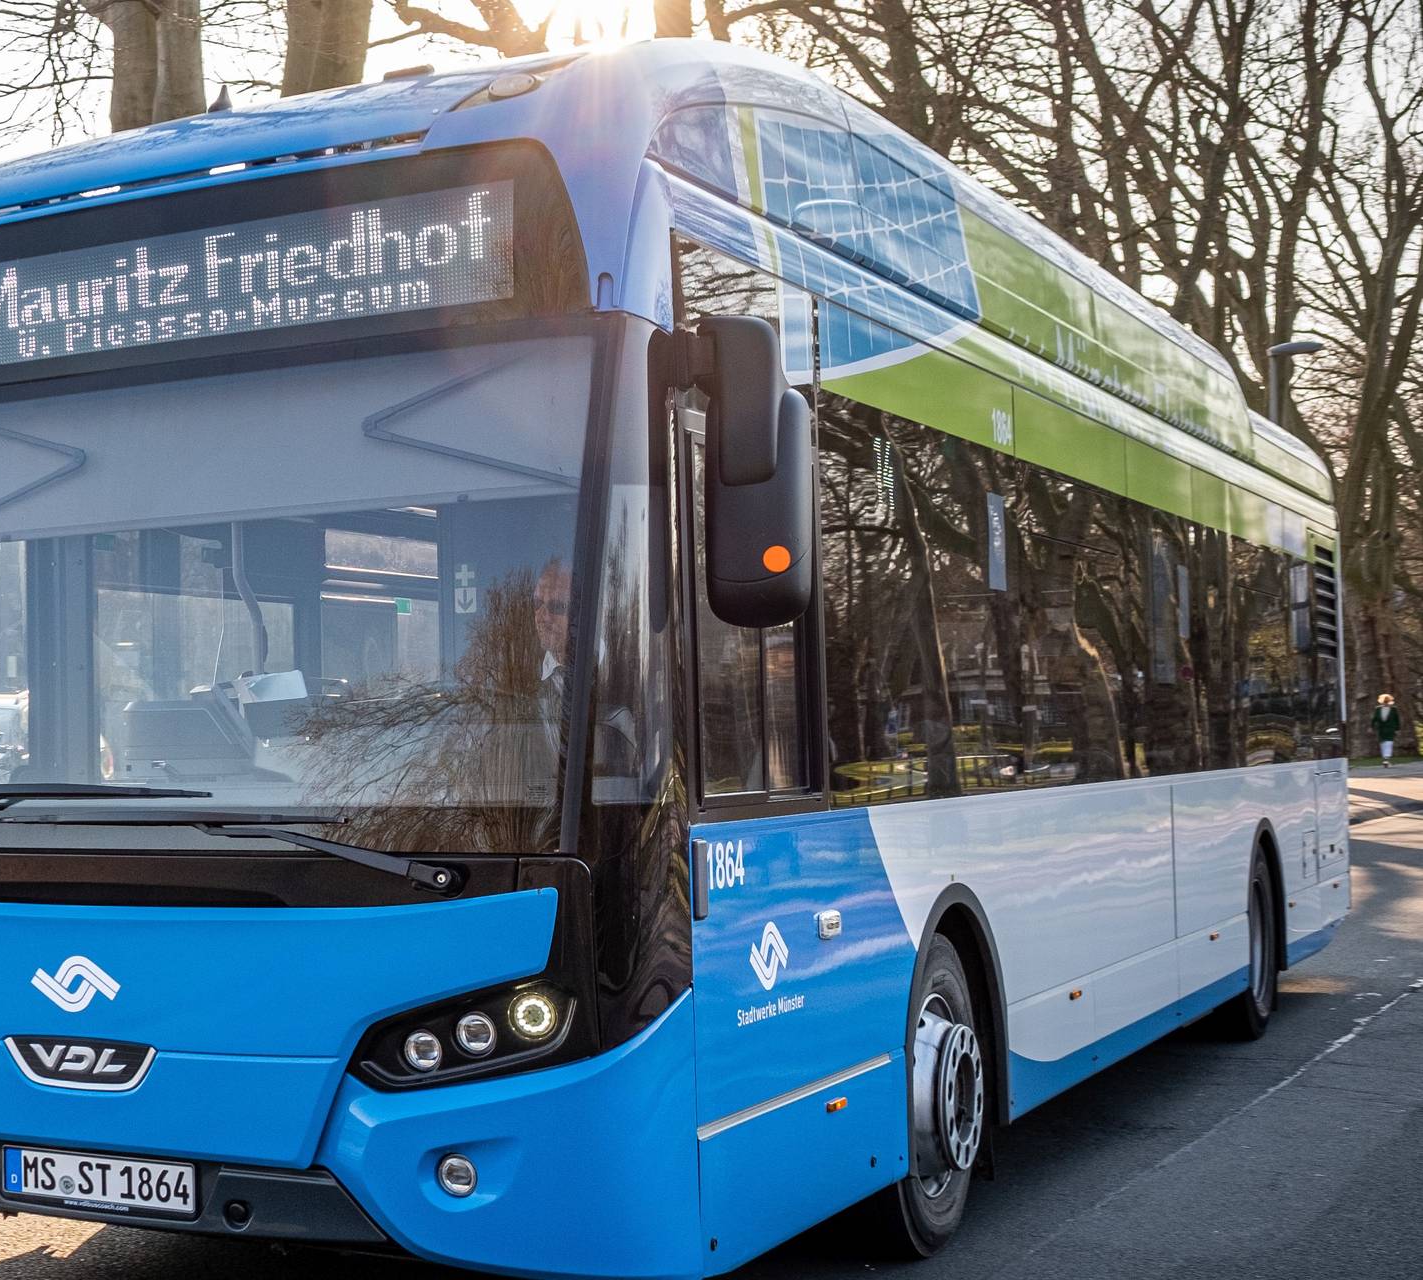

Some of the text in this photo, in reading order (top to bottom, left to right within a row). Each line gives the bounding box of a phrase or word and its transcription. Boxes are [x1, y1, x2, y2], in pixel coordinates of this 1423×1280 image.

[205, 191, 491, 299] Friedhof
[66, 280, 430, 352] Picasso-Museum
[707, 839, 745, 890] 1864
[737, 994, 805, 1027] Stadtwerke Münster
[29, 1043, 127, 1074] VDL
[10, 1173, 18, 1184] D
[23, 1155, 190, 1205] MS ST 1864
